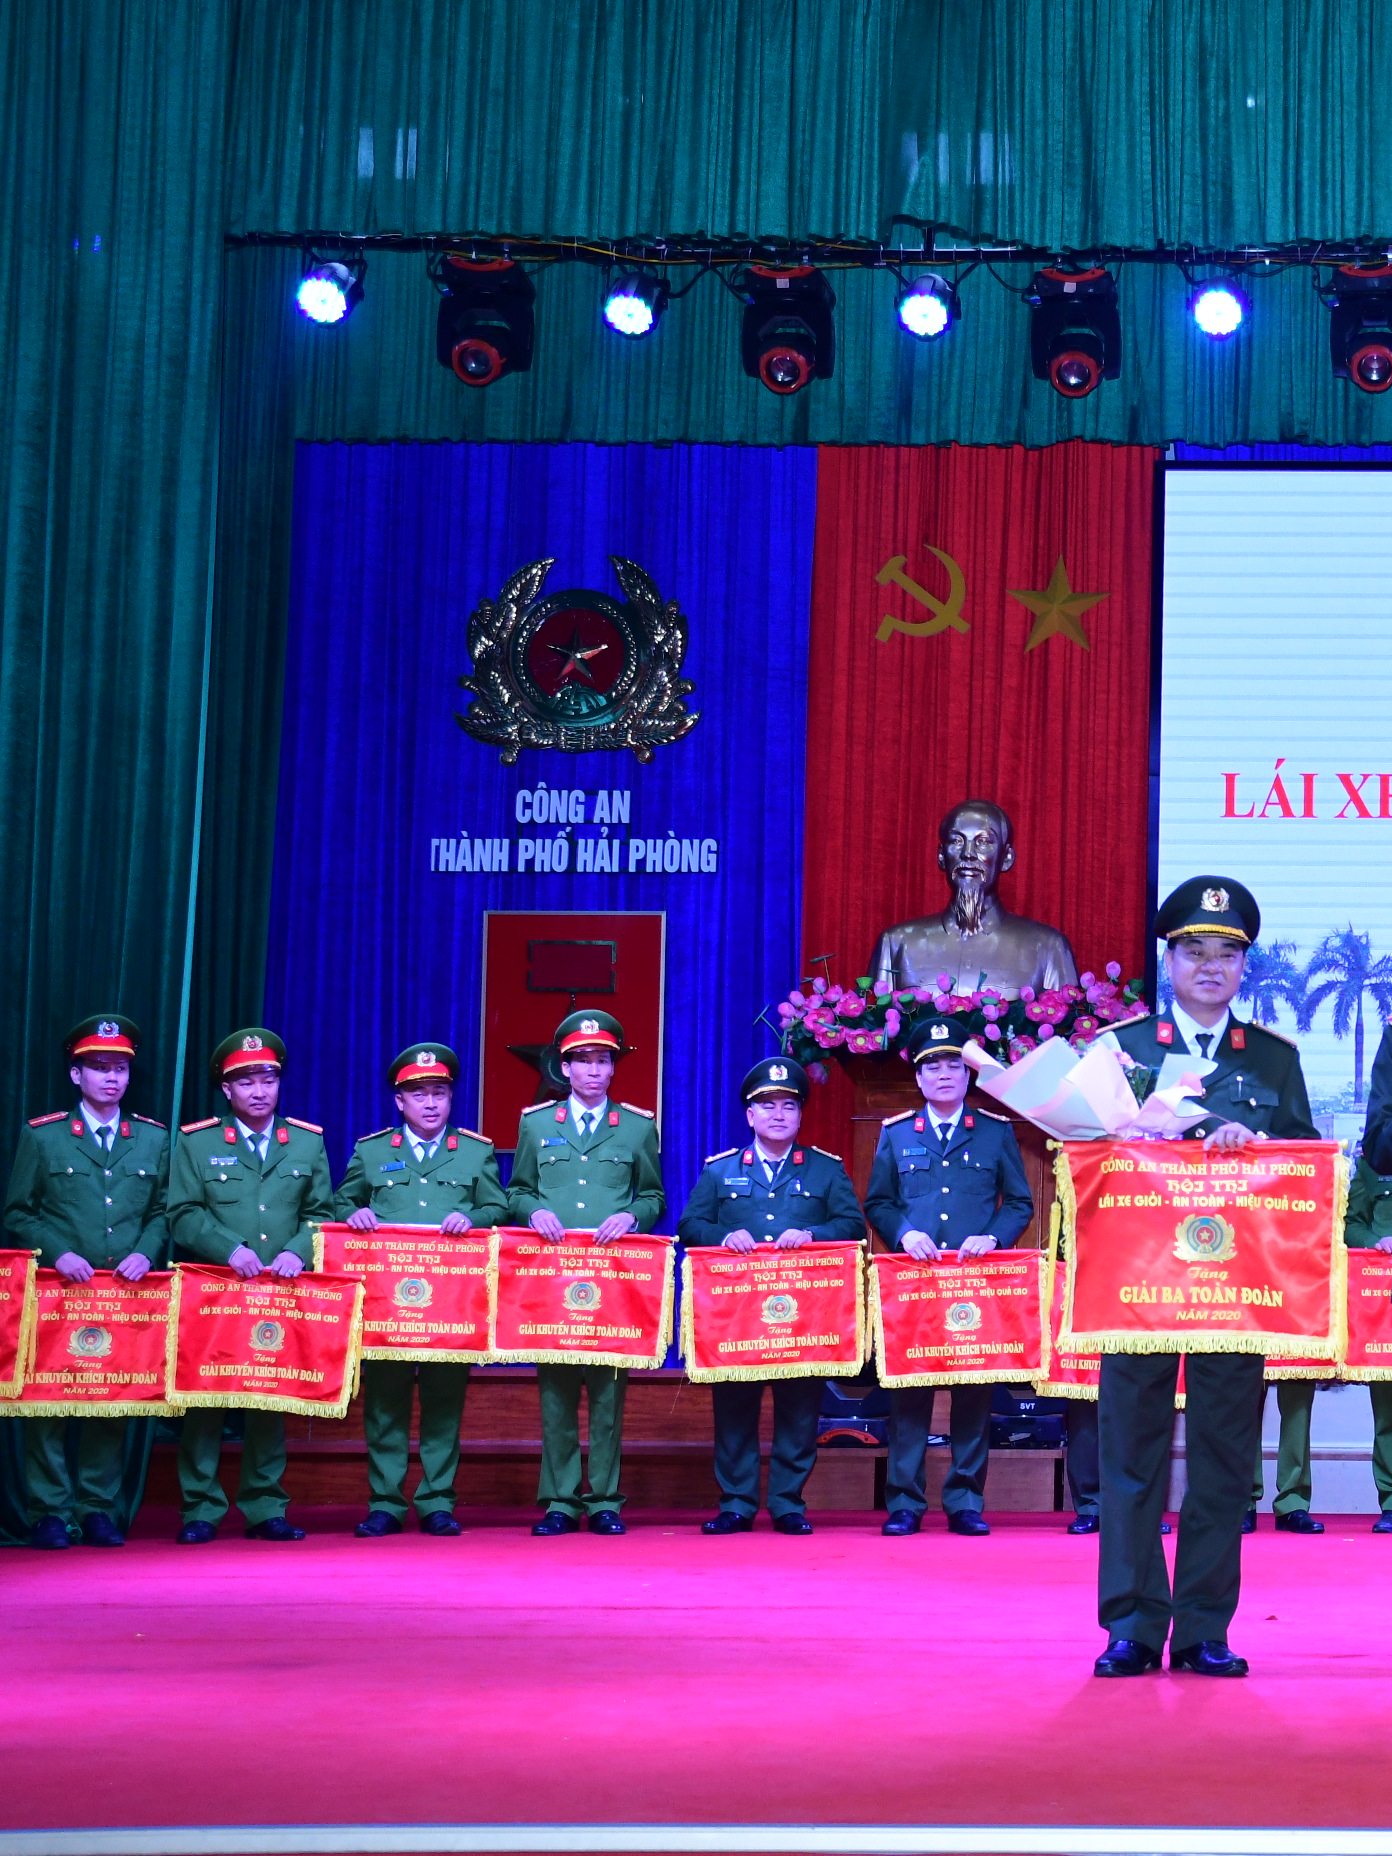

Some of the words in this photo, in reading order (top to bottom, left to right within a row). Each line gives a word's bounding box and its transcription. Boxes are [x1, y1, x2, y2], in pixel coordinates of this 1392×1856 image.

[1221, 758, 1318, 819] LÁI
[516, 782, 585, 824] CÔNG
[594, 790, 631, 823] AN
[518, 827, 572, 872] PHỐ
[577, 827, 619, 872] HẢI
[628, 831, 718, 872] PHÒNG
[1101, 1157, 1134, 1174] CÔNG
[1138, 1161, 1156, 1172] AN
[1161, 1162, 1207, 1175] THÀNH
[1211, 1159, 1239, 1174] PHỐ
[1242, 1160, 1266, 1175] HẢI
[1270, 1163, 1315, 1177] PHÒNG
[1167, 1179, 1204, 1194] HỘI
[1211, 1180, 1248, 1193] THI
[1099, 1194, 1114, 1208] LÁI
[1117, 1196, 1131, 1207] XE
[1134, 1192, 1162, 1207] GIỎI
[1173, 1196, 1189, 1207] AN
[1193, 1195, 1225, 1207] TOÀN
[1236, 1194, 1261, 1210] HIỆU
[1264, 1195, 1288, 1210] QUẢ
[1292, 1200, 1316, 1212] CAO
[1187, 1267, 1228, 1281] Tặng
[1120, 1281, 1157, 1303] GIẢI
[1162, 1287, 1185, 1303] BA
[1189, 1282, 1237, 1303] TOÀN
[1241, 1285, 1283, 1307] ĐOÀN
[1176, 1309, 1208, 1320] NĂM
[1211, 1311, 1241, 1320] 2020
